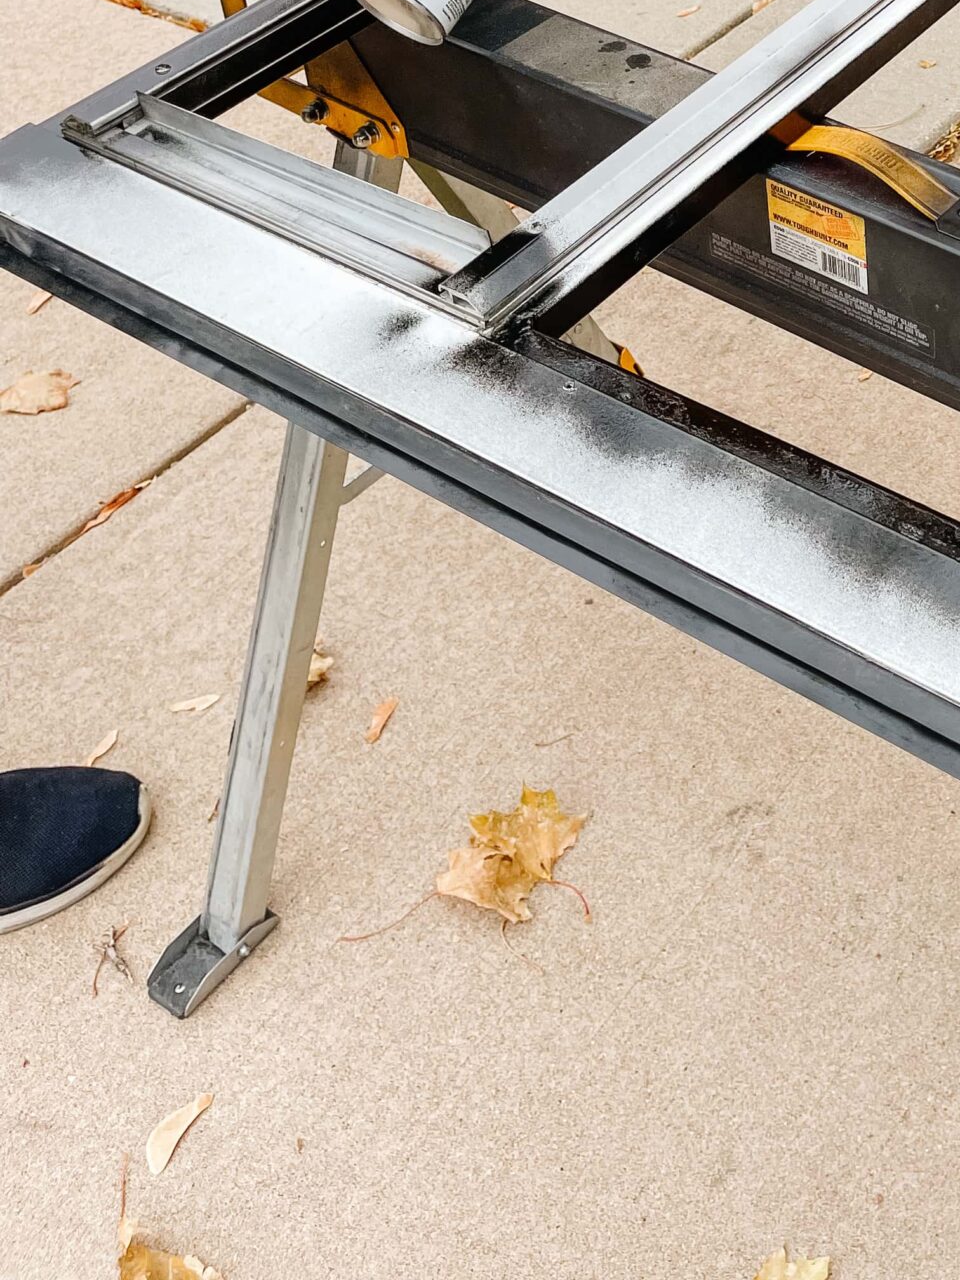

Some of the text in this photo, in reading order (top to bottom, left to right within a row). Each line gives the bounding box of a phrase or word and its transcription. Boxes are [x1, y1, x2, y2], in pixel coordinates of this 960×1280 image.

[770, 183, 797, 200] QUALITY
[799, 195, 843, 219] GUARANTEED
[773, 212, 848, 250] WWW.TOUGHBUILT.COM
[872, 311, 896, 326] WEIGHT
[877, 307, 886, 316] DO
[886, 312, 899, 322] NOT
